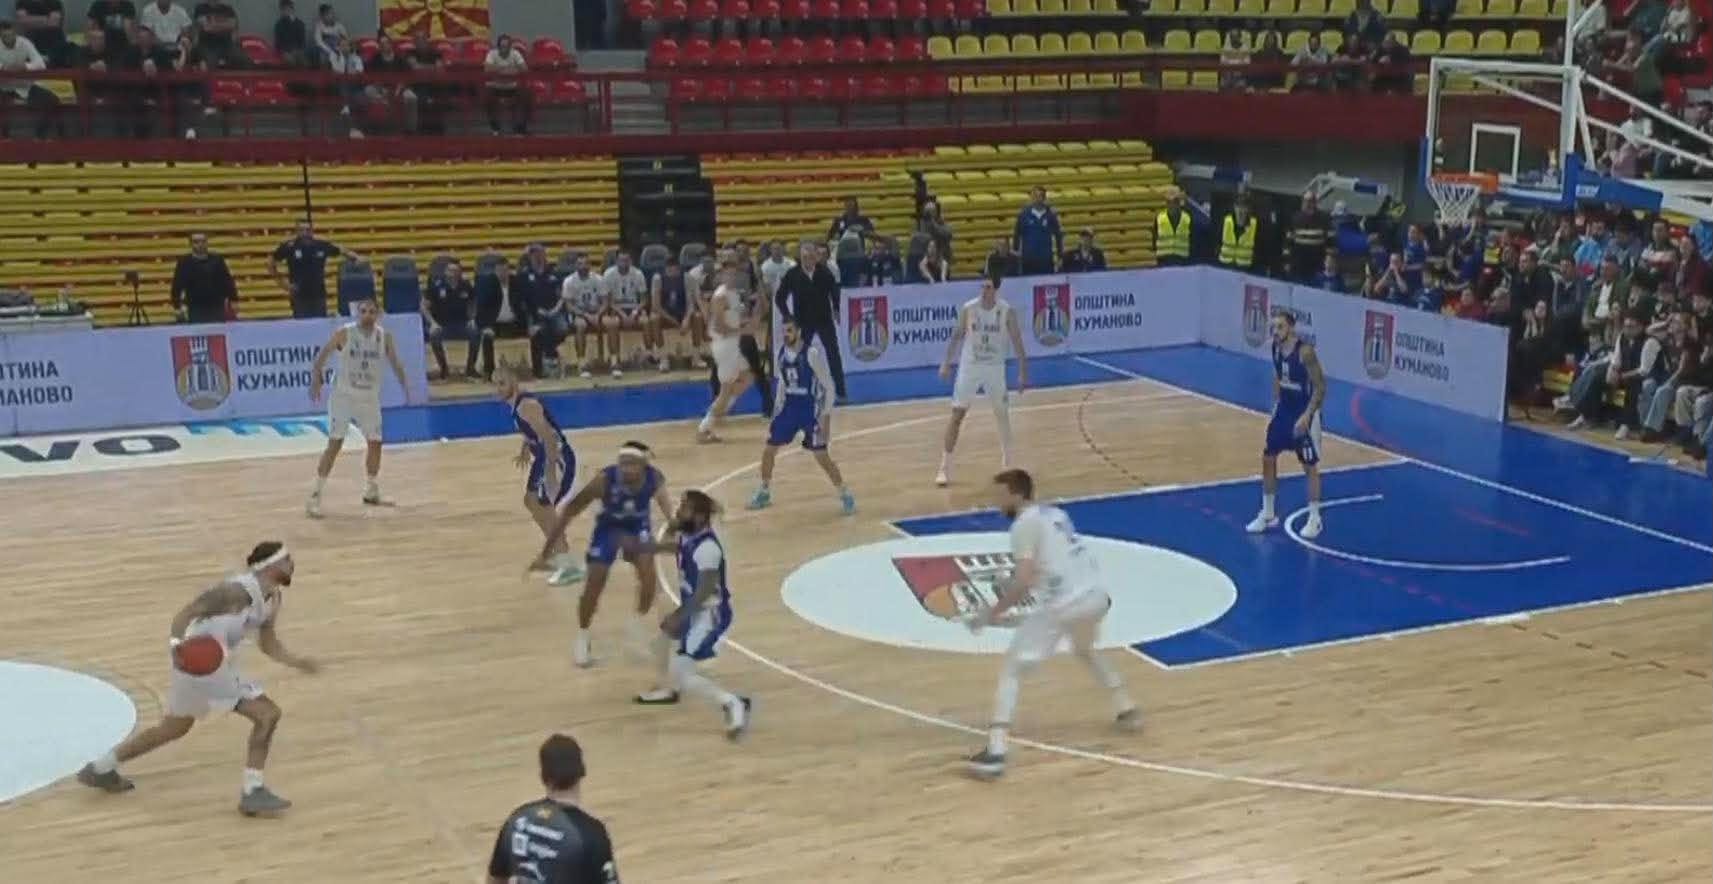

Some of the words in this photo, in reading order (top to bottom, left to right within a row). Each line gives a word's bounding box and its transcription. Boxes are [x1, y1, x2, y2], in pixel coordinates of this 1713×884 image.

[1074, 293, 1136, 310] ОПШТИНА
[892, 305, 959, 323] ОПШТИНА
[1074, 311, 1143, 331] КУМАНОВО
